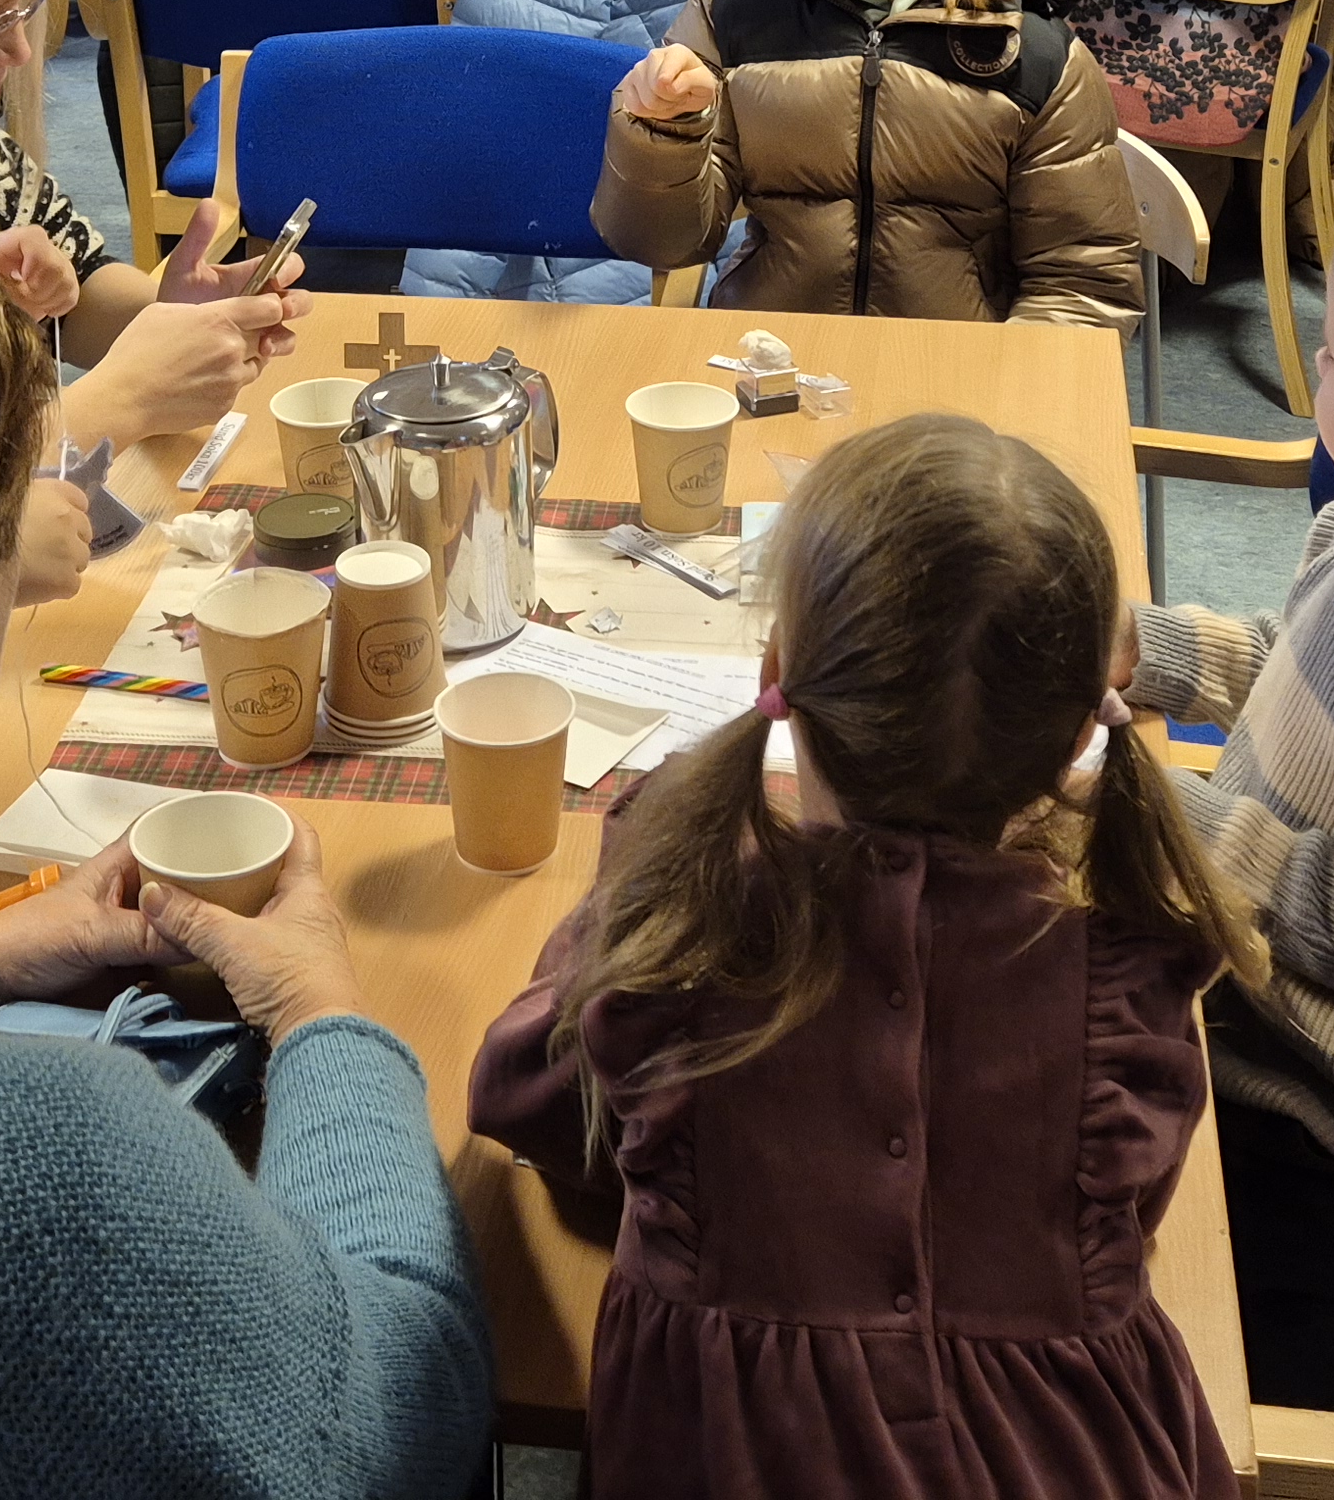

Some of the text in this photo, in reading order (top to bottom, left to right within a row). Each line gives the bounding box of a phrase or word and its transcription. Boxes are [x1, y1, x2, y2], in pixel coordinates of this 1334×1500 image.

[953, 40, 1007, 72] COLLECTION
[631, 531, 647, 542] kr
[643, 540, 662, 551] 10
